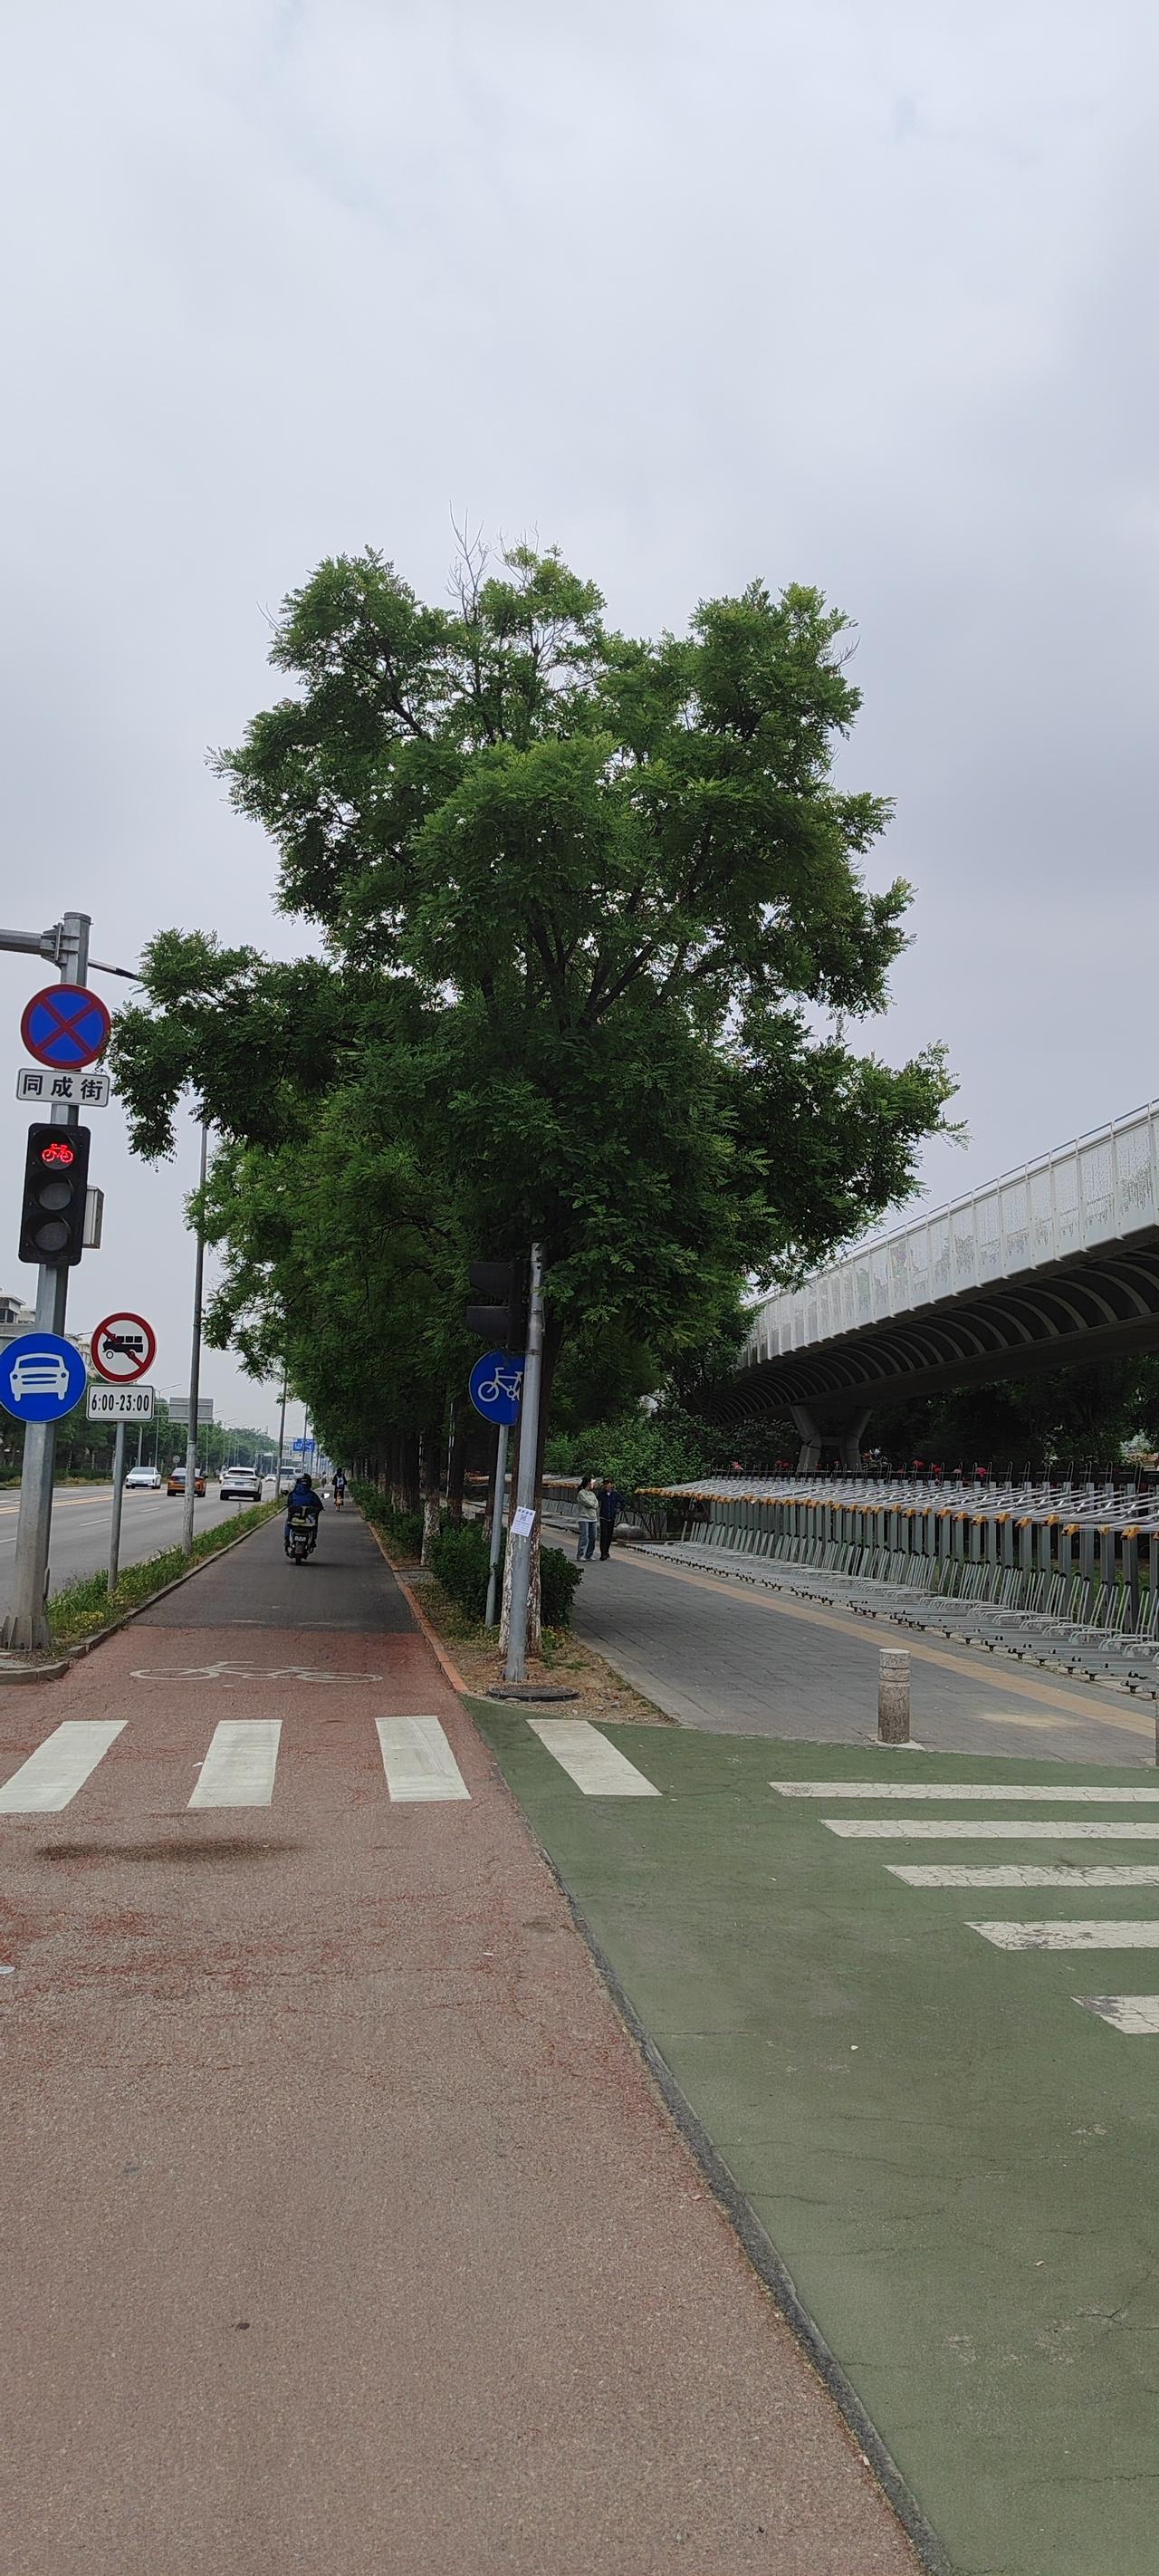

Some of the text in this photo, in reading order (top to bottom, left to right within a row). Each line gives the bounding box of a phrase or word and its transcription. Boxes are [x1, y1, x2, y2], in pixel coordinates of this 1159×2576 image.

[23, 1074, 103, 1101] 同成街
[91, 1394, 149, 1411] 6:00-23:00
